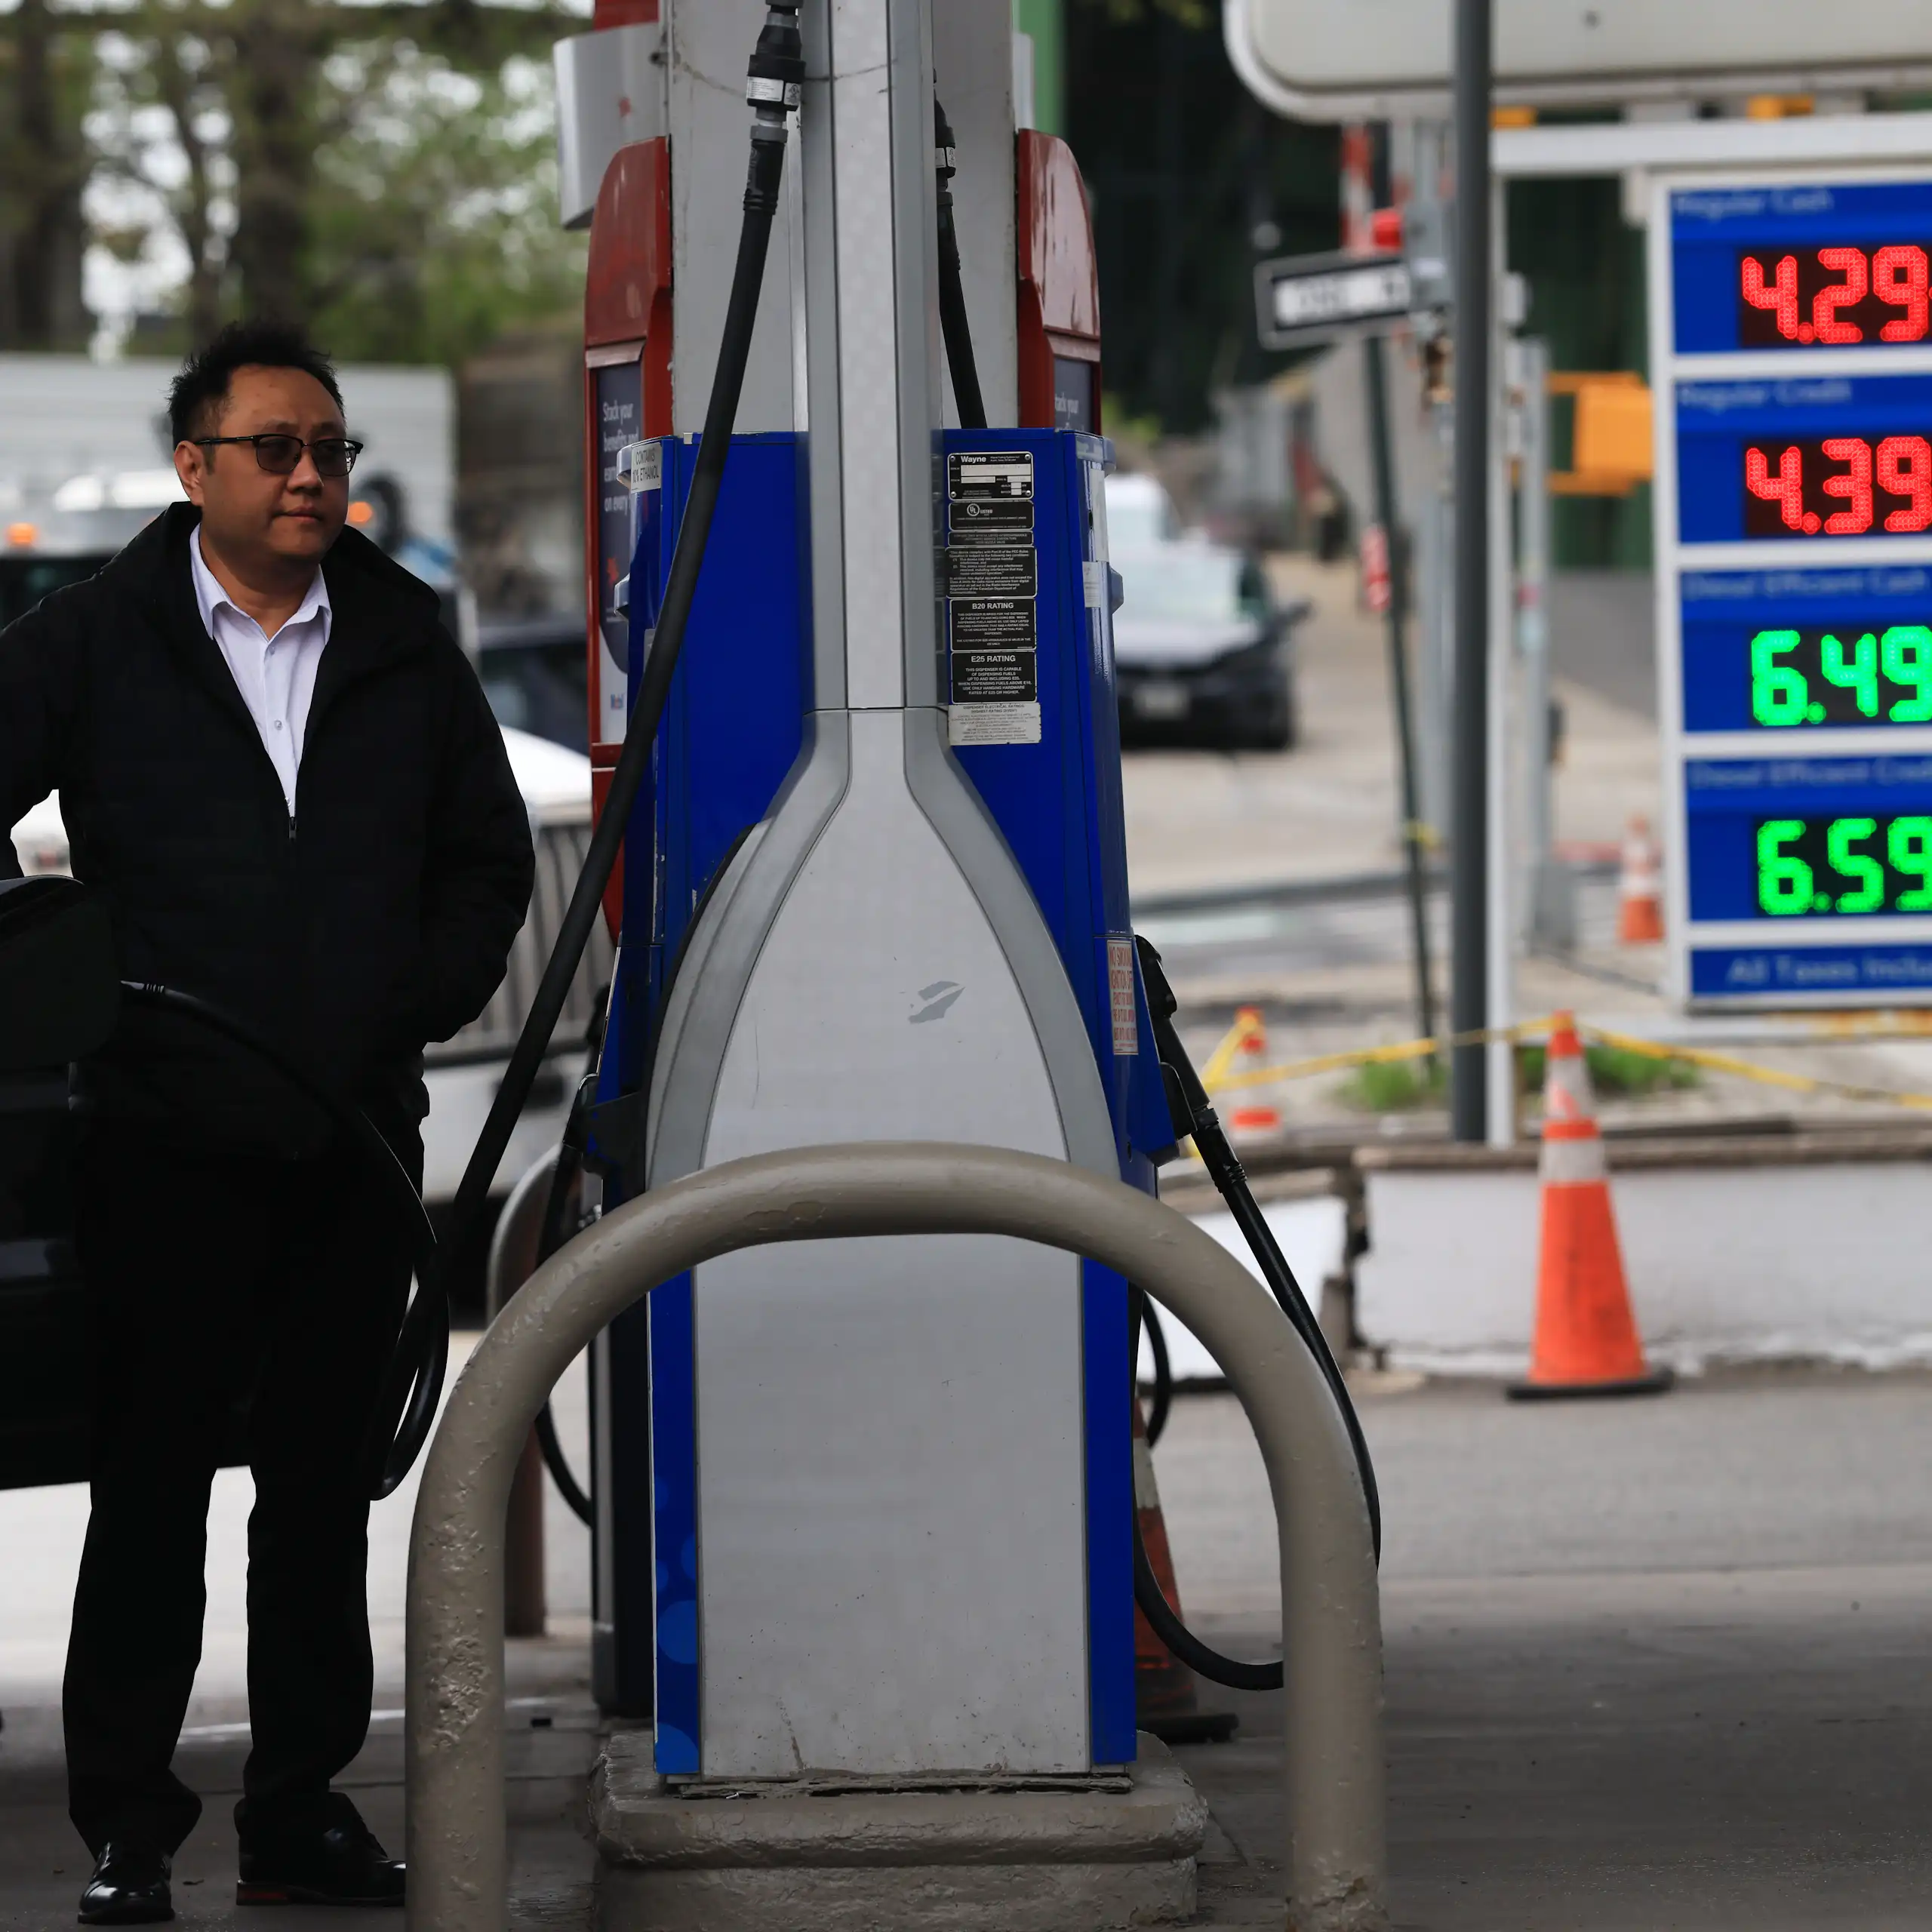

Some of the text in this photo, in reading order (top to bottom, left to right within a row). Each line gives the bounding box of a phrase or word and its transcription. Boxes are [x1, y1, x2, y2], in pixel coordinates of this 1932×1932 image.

[1742, 245, 1928, 344] 4.29
[1746, 436, 1932, 534] 4.39
[1751, 626, 1932, 726] 6.49
[1757, 816, 1932, 915] 6.59
